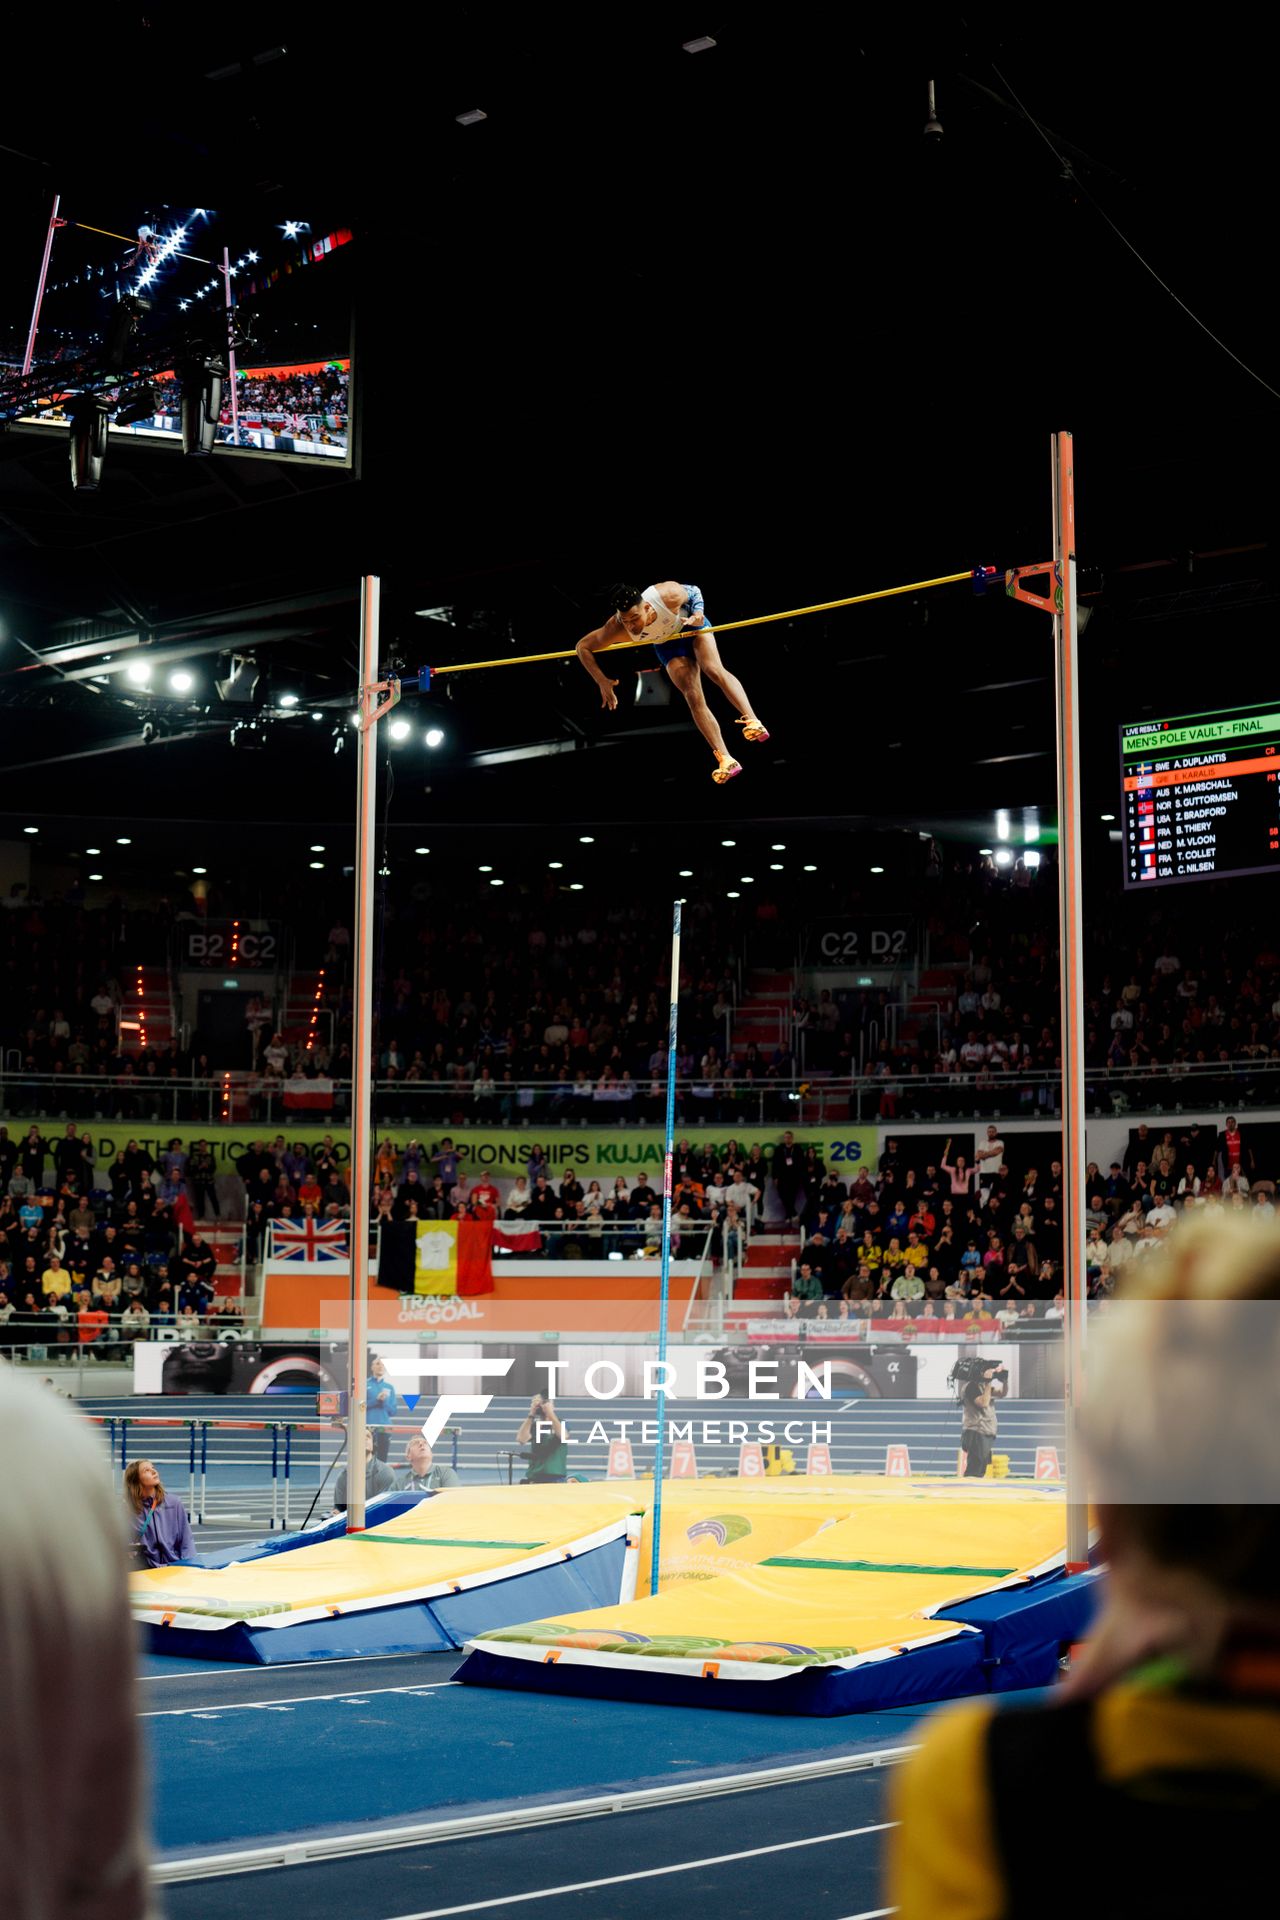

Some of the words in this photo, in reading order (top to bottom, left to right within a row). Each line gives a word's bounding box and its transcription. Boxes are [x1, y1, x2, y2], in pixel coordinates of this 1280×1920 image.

[1126, 727, 1138, 736] LIVE
[1139, 724, 1161, 734] RESULT
[1127, 736, 1157, 749] MEN'S
[1160, 731, 1186, 744] POLE
[1189, 725, 1223, 740] VAULT
[1232, 720, 1263, 733] FINAL
[1155, 762, 1170, 771] SWE
[1183, 753, 1226, 768] DUPLANTIS
[1265, 747, 1276, 755] CR
[1182, 768, 1216, 781] KARALIS
[1128, 793, 1134, 801] 3
[1156, 788, 1170, 798] AUS
[1183, 779, 1232, 794] MARSCHALL
[1267, 774, 1276, 782] PB
[1129, 806, 1134, 814] 4
[1156, 801, 1171, 811] NOR
[1183, 791, 1238, 807] GUTTORMSEN
[1129, 819, 1135, 827] 5
[1157, 814, 1171, 824] USA
[1183, 806, 1227, 820] BRADFORD
[1130, 832, 1135, 841] 6
[1157, 828, 1171, 837] FRA
[1184, 821, 1212, 834] THIERY
[1130, 845, 1136, 854] 7
[1158, 840, 1172, 850] NED
[1187, 834, 1216, 847] VLOON
[1131, 858, 1136, 867] 8
[1158, 854, 1172, 863] FRA
[1185, 848, 1216, 860] COLLET
[1131, 872, 1137, 880] 9
[1159, 867, 1173, 876] USA
[1186, 861, 1215, 873] NILSEN
[188, 934, 223, 957] B2
[238, 935, 276, 958] C2
[820, 931, 858, 957] C2
[871, 930, 907, 954] D2
[829, 1141, 862, 1162] 26
[426, 1301, 485, 1324] GOAL
[614, 1451, 629, 1472] 8
[675, 1453, 690, 1473] 7
[743, 1455, 759, 1475] 6
[812, 1456, 827, 1475] 5
[890, 1457, 905, 1476] 4
[1039, 1460, 1055, 1479] 2
